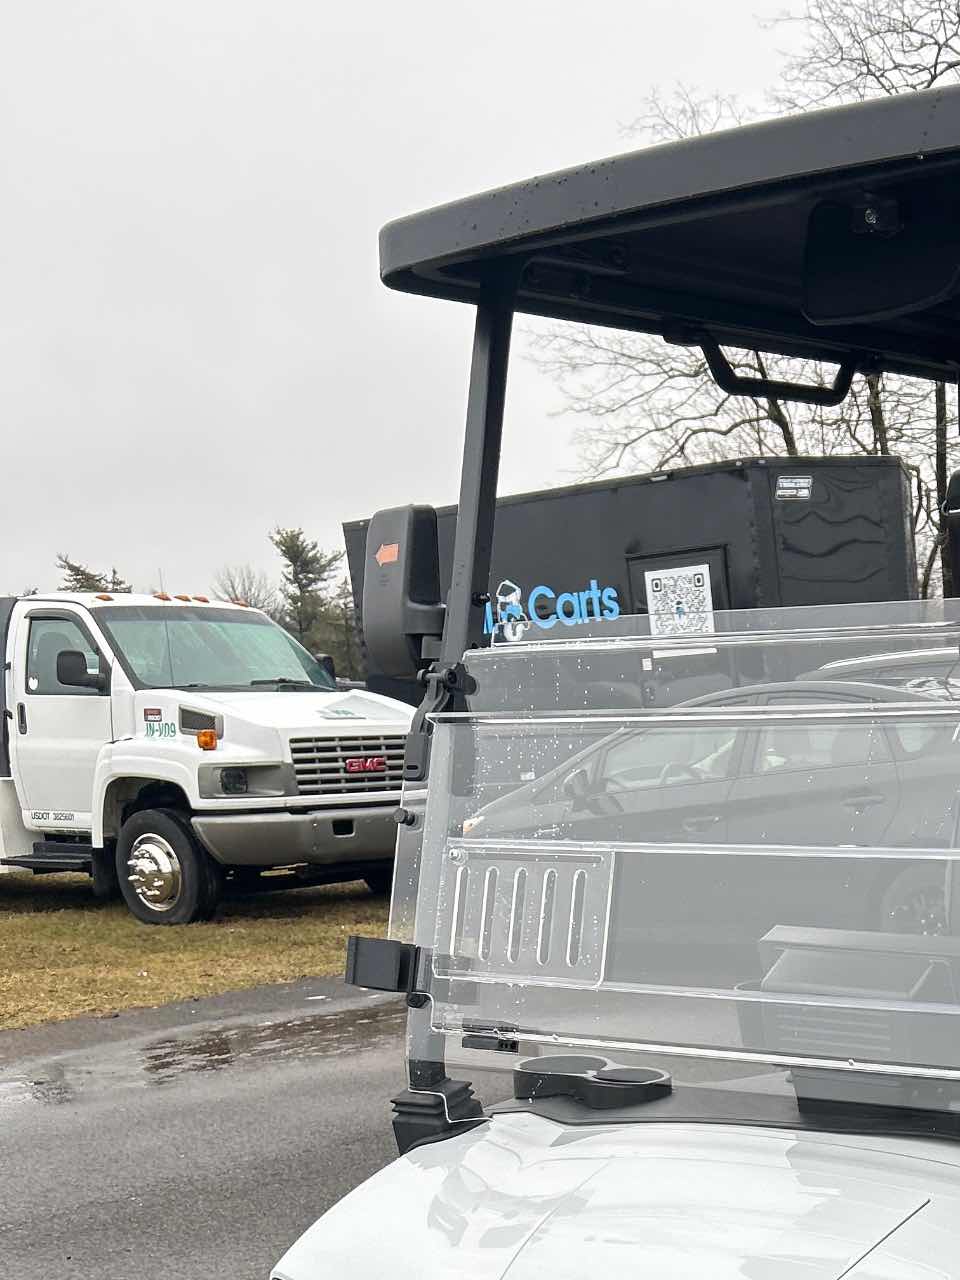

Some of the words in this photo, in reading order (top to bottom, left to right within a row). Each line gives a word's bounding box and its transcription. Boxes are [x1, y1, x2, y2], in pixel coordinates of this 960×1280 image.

[528, 579, 621, 629] Carts
[345, 757, 385, 772] GMC
[31, 811, 50, 820] USDOT
